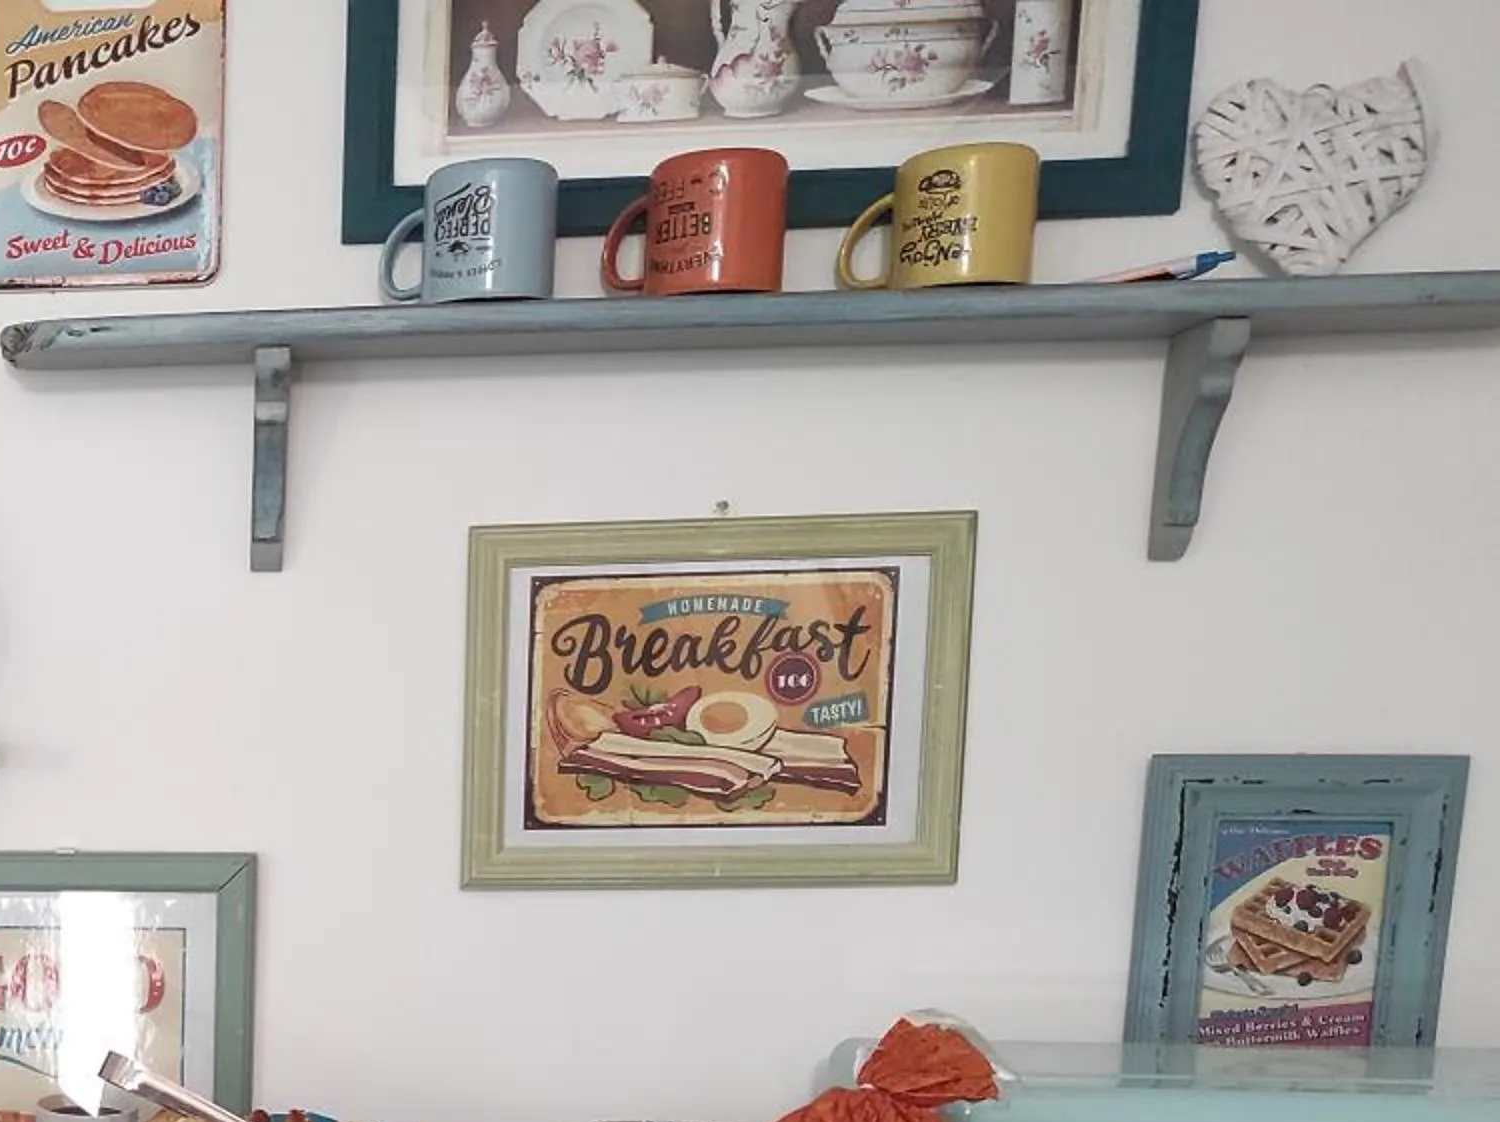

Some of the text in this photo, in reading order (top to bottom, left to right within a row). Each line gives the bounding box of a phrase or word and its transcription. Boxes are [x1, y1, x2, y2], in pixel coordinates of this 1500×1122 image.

[6, 13, 135, 54] American
[6, 13, 201, 99] Pancakes
[6, 229, 197, 265] Sweet & Delicious
[666, 597, 764, 616] HOMEMADE
[551, 604, 873, 695] Breakfast
[809, 697, 864, 724] TASTY!
[1198, 1022, 1242, 1037] Mixed
[1244, 1017, 1297, 1031] Berries
[1318, 1013, 1367, 1026] Cream
